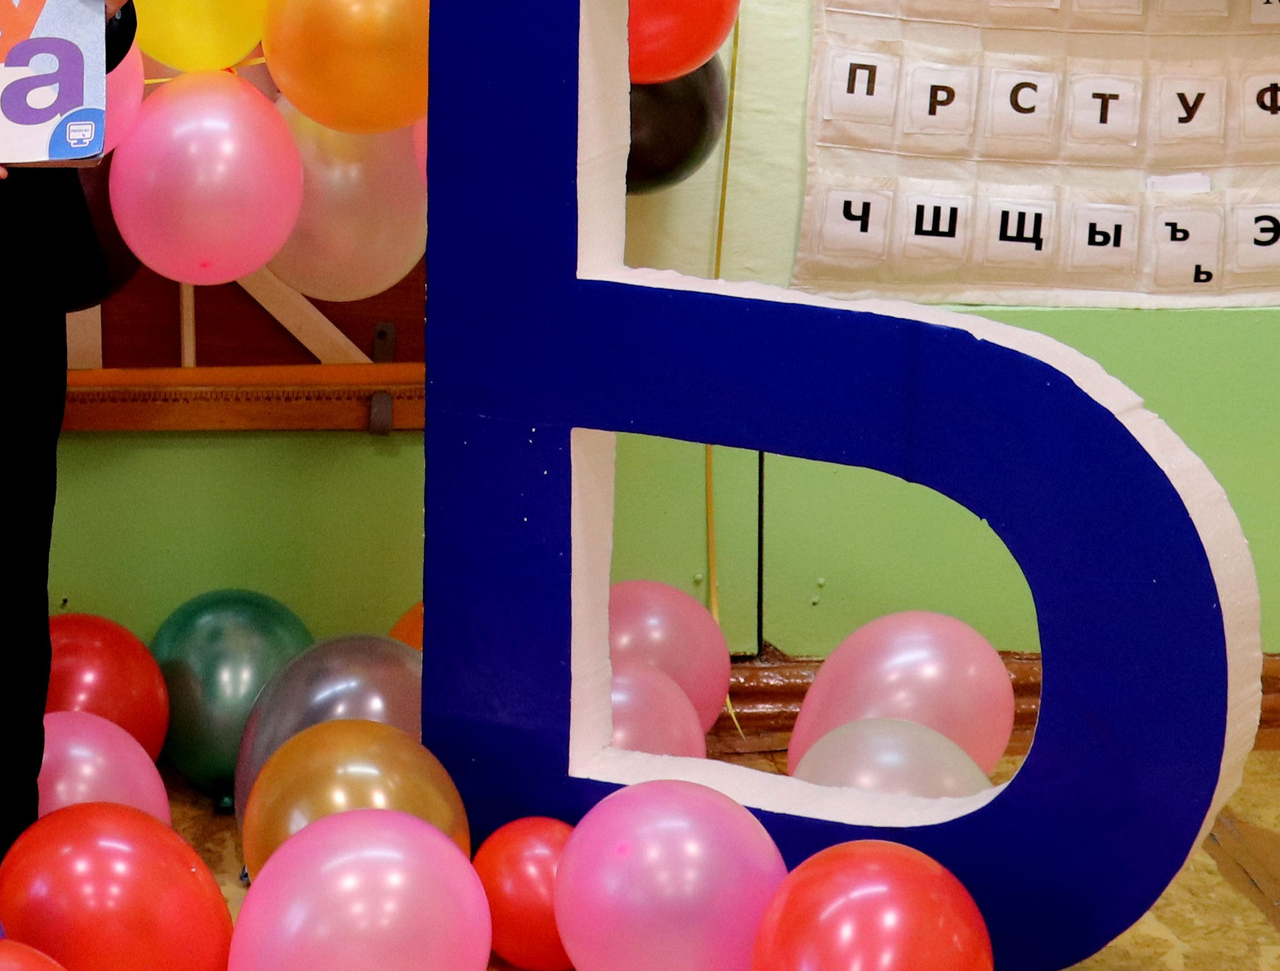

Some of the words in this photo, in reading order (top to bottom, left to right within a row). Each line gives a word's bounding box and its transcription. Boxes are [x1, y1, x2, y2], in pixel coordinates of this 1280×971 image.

[846, 62, 877, 96] П
[928, 85, 955, 116] Р
[1009, 82, 1038, 114] С
[1091, 93, 1119, 124] Т
[1176, 92, 1206, 124] У
[1256, 83, 1280, 115] Ф
[842, 200, 871, 233] Ч
[914, 204, 959, 238] Ш
[999, 211, 1044, 251] Щ
[1253, 215, 1280, 246] Э
